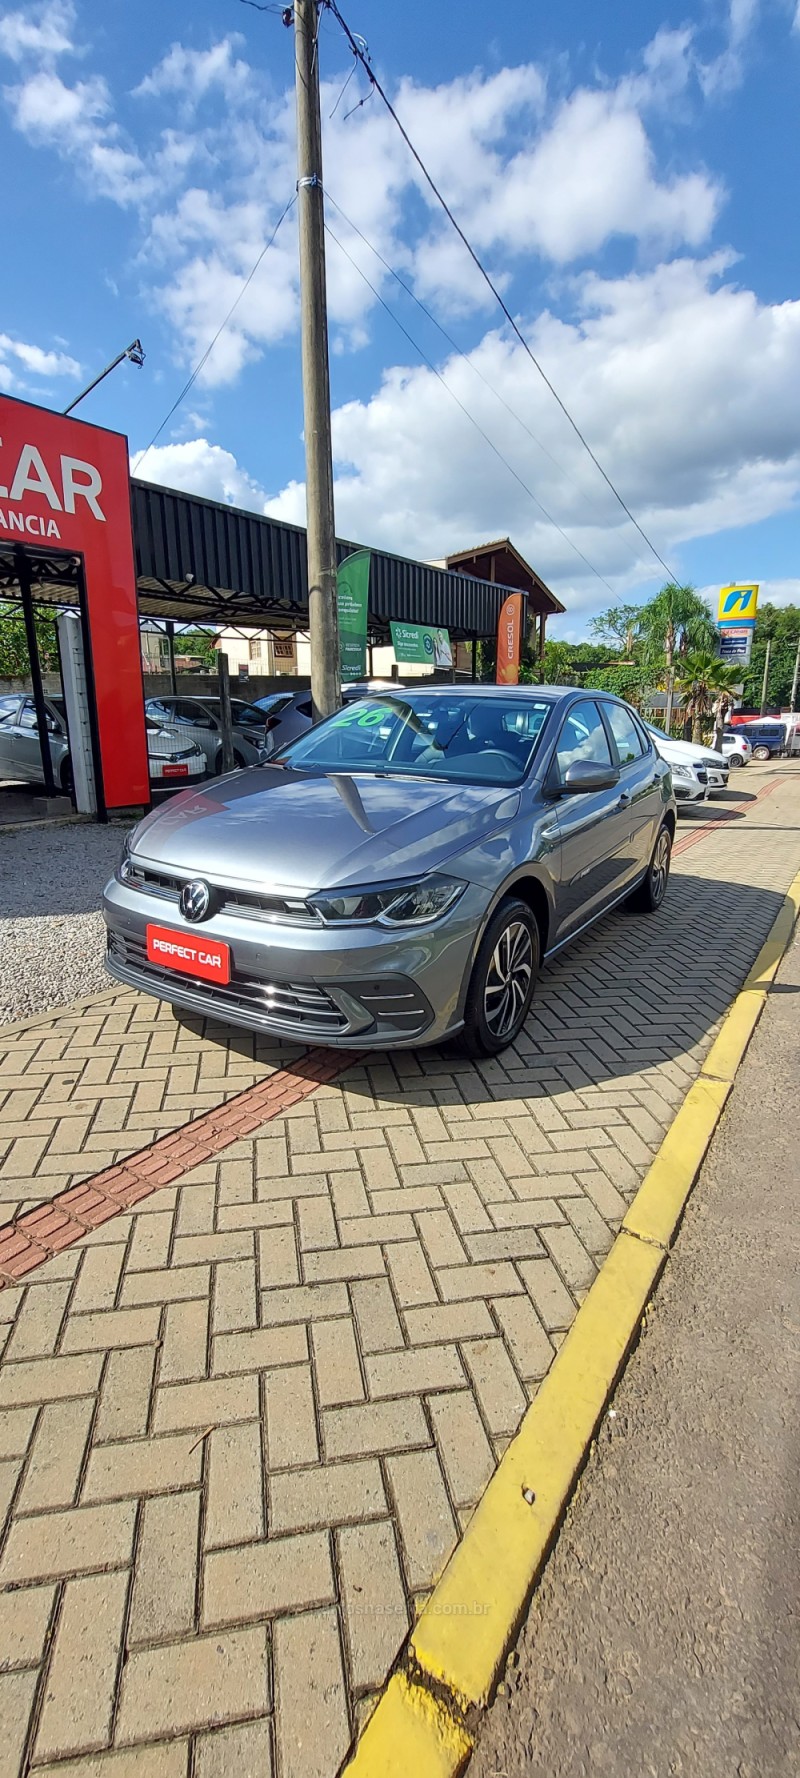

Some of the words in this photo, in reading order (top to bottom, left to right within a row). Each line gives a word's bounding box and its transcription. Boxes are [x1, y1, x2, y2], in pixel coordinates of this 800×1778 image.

[0, 436, 107, 522] AR
[402, 630, 419, 640] Sicredi
[328, 707, 392, 727] 26
[153, 938, 196, 961] PERFECT
[198, 952, 221, 968] CAR
